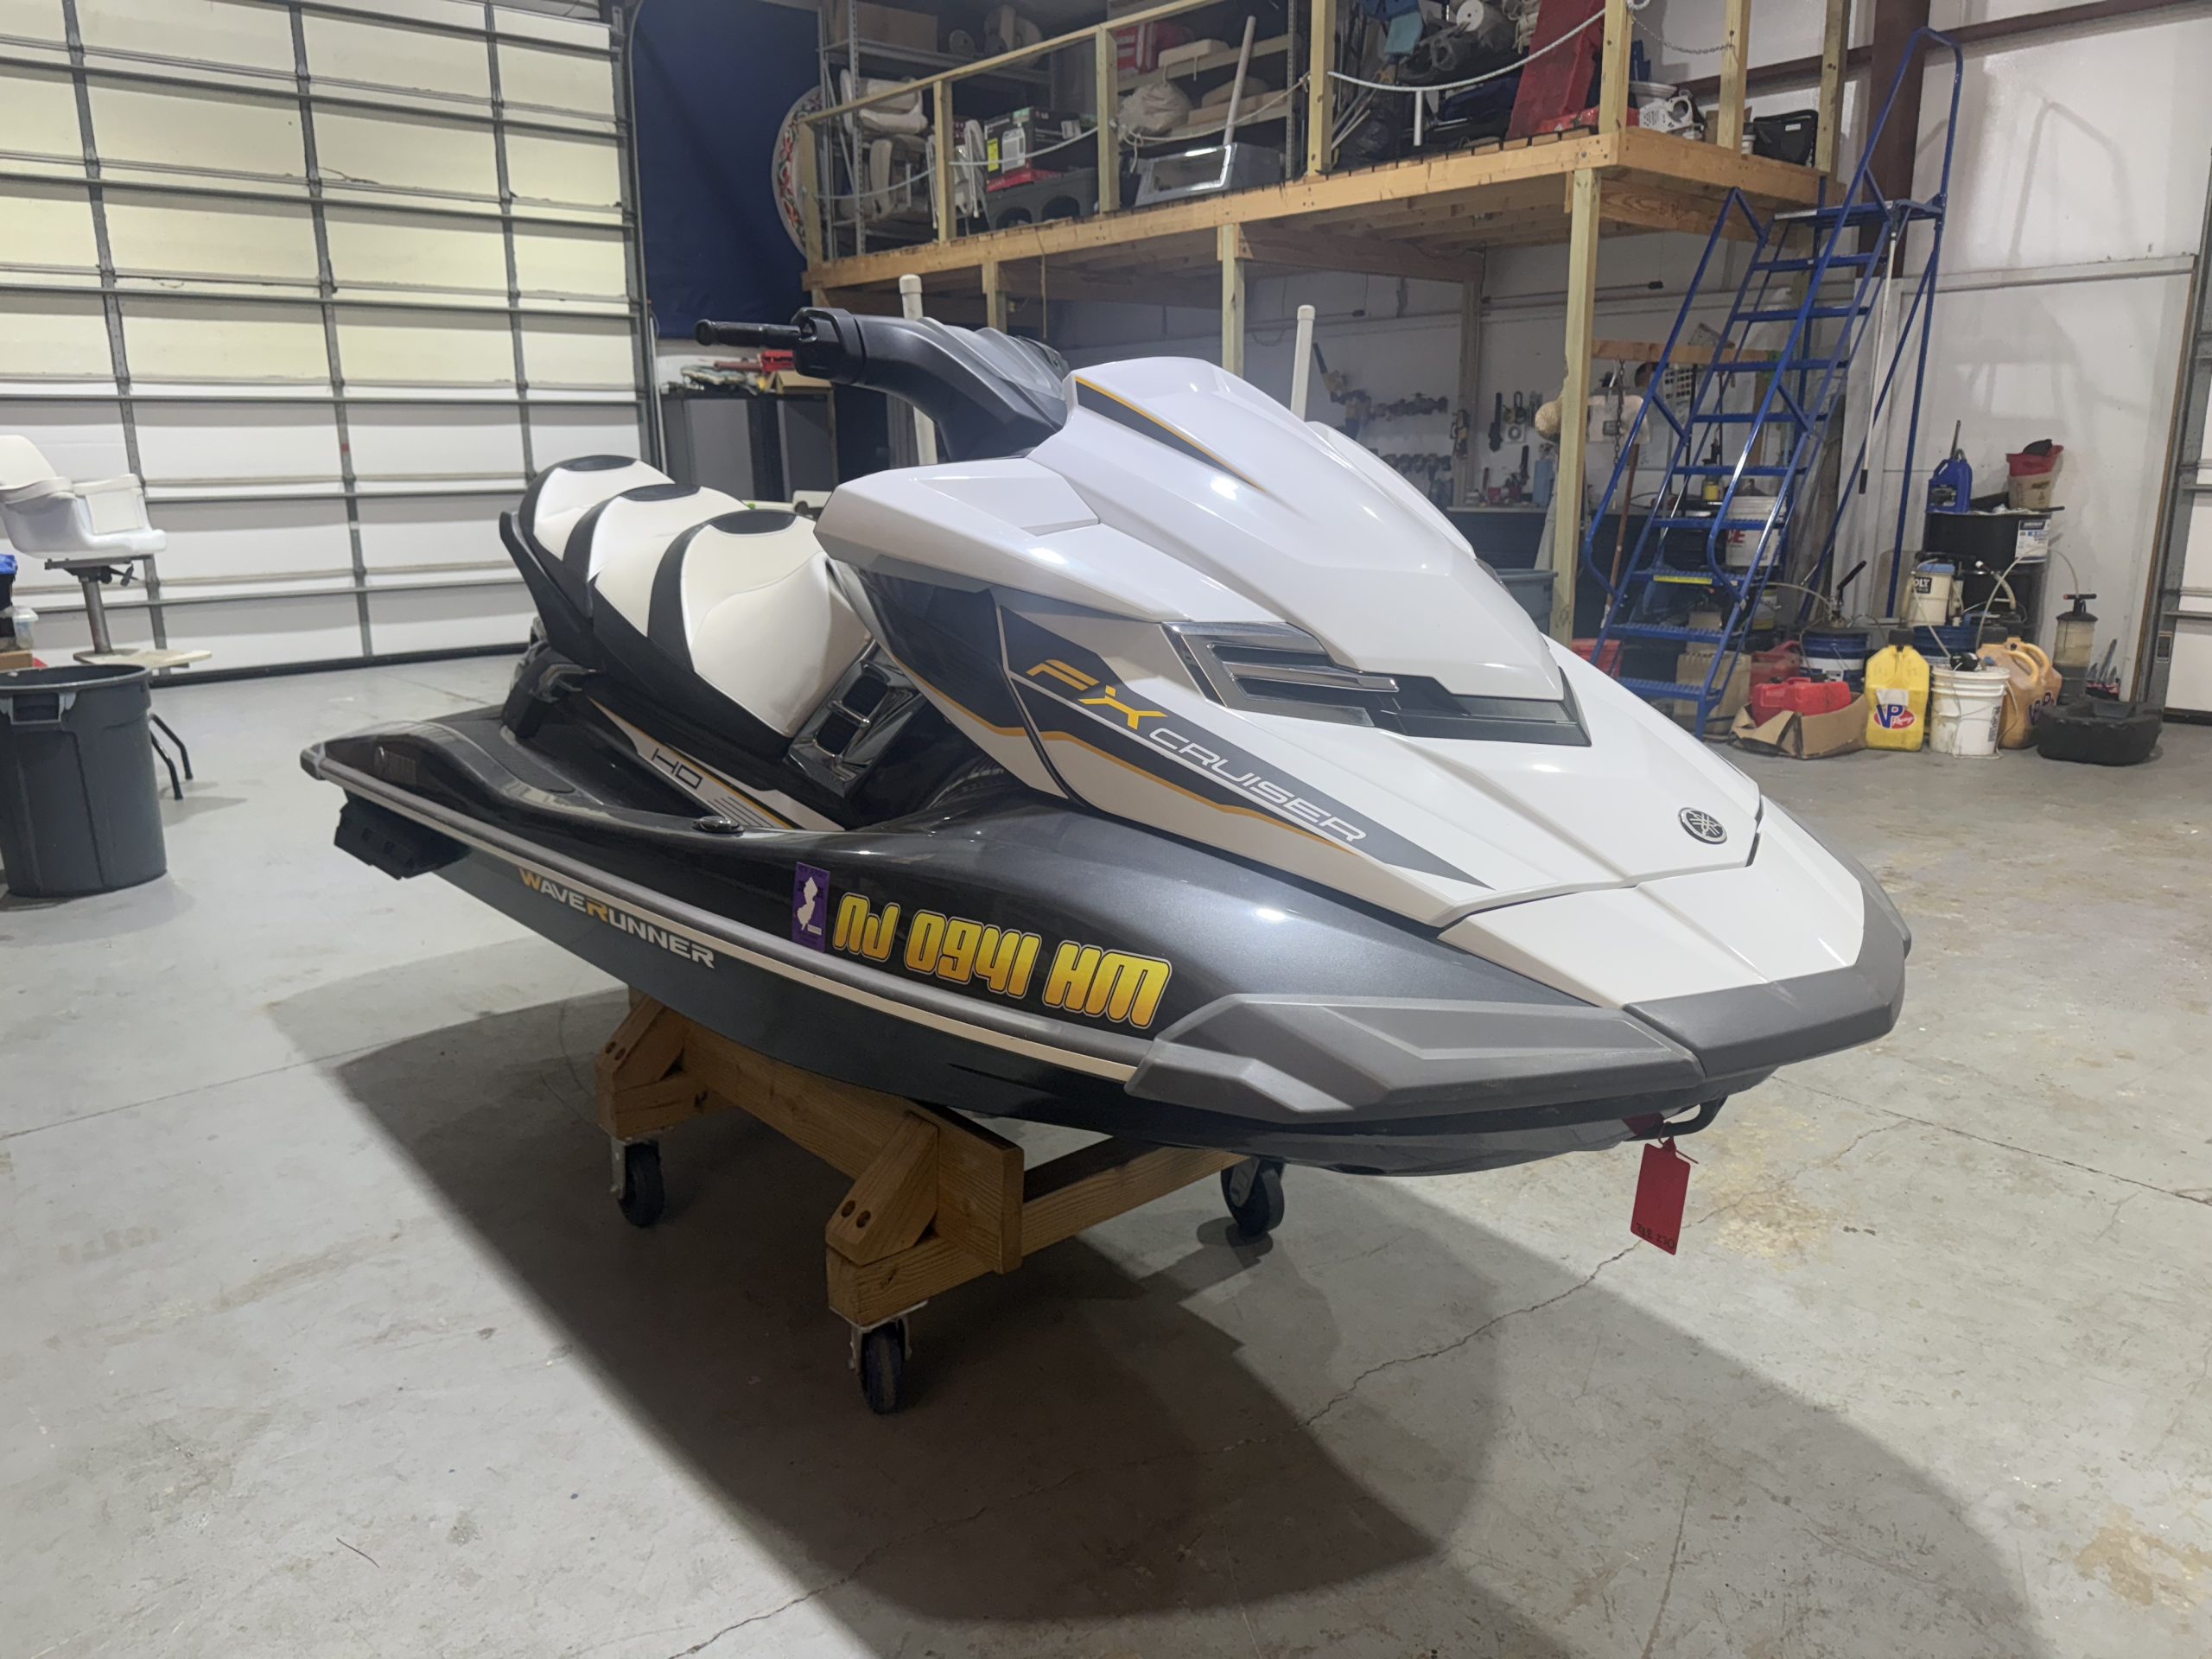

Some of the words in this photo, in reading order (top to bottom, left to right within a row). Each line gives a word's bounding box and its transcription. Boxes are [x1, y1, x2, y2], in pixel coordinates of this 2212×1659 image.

[1027, 658, 1167, 731] FX
[1148, 727, 1367, 844] CRUISER
[1876, 703, 1904, 728] VP
[652, 748, 702, 790] HO
[833, 893, 900, 961] NJ
[904, 910, 1041, 999] 0941
[1043, 939, 1173, 1029] HM
